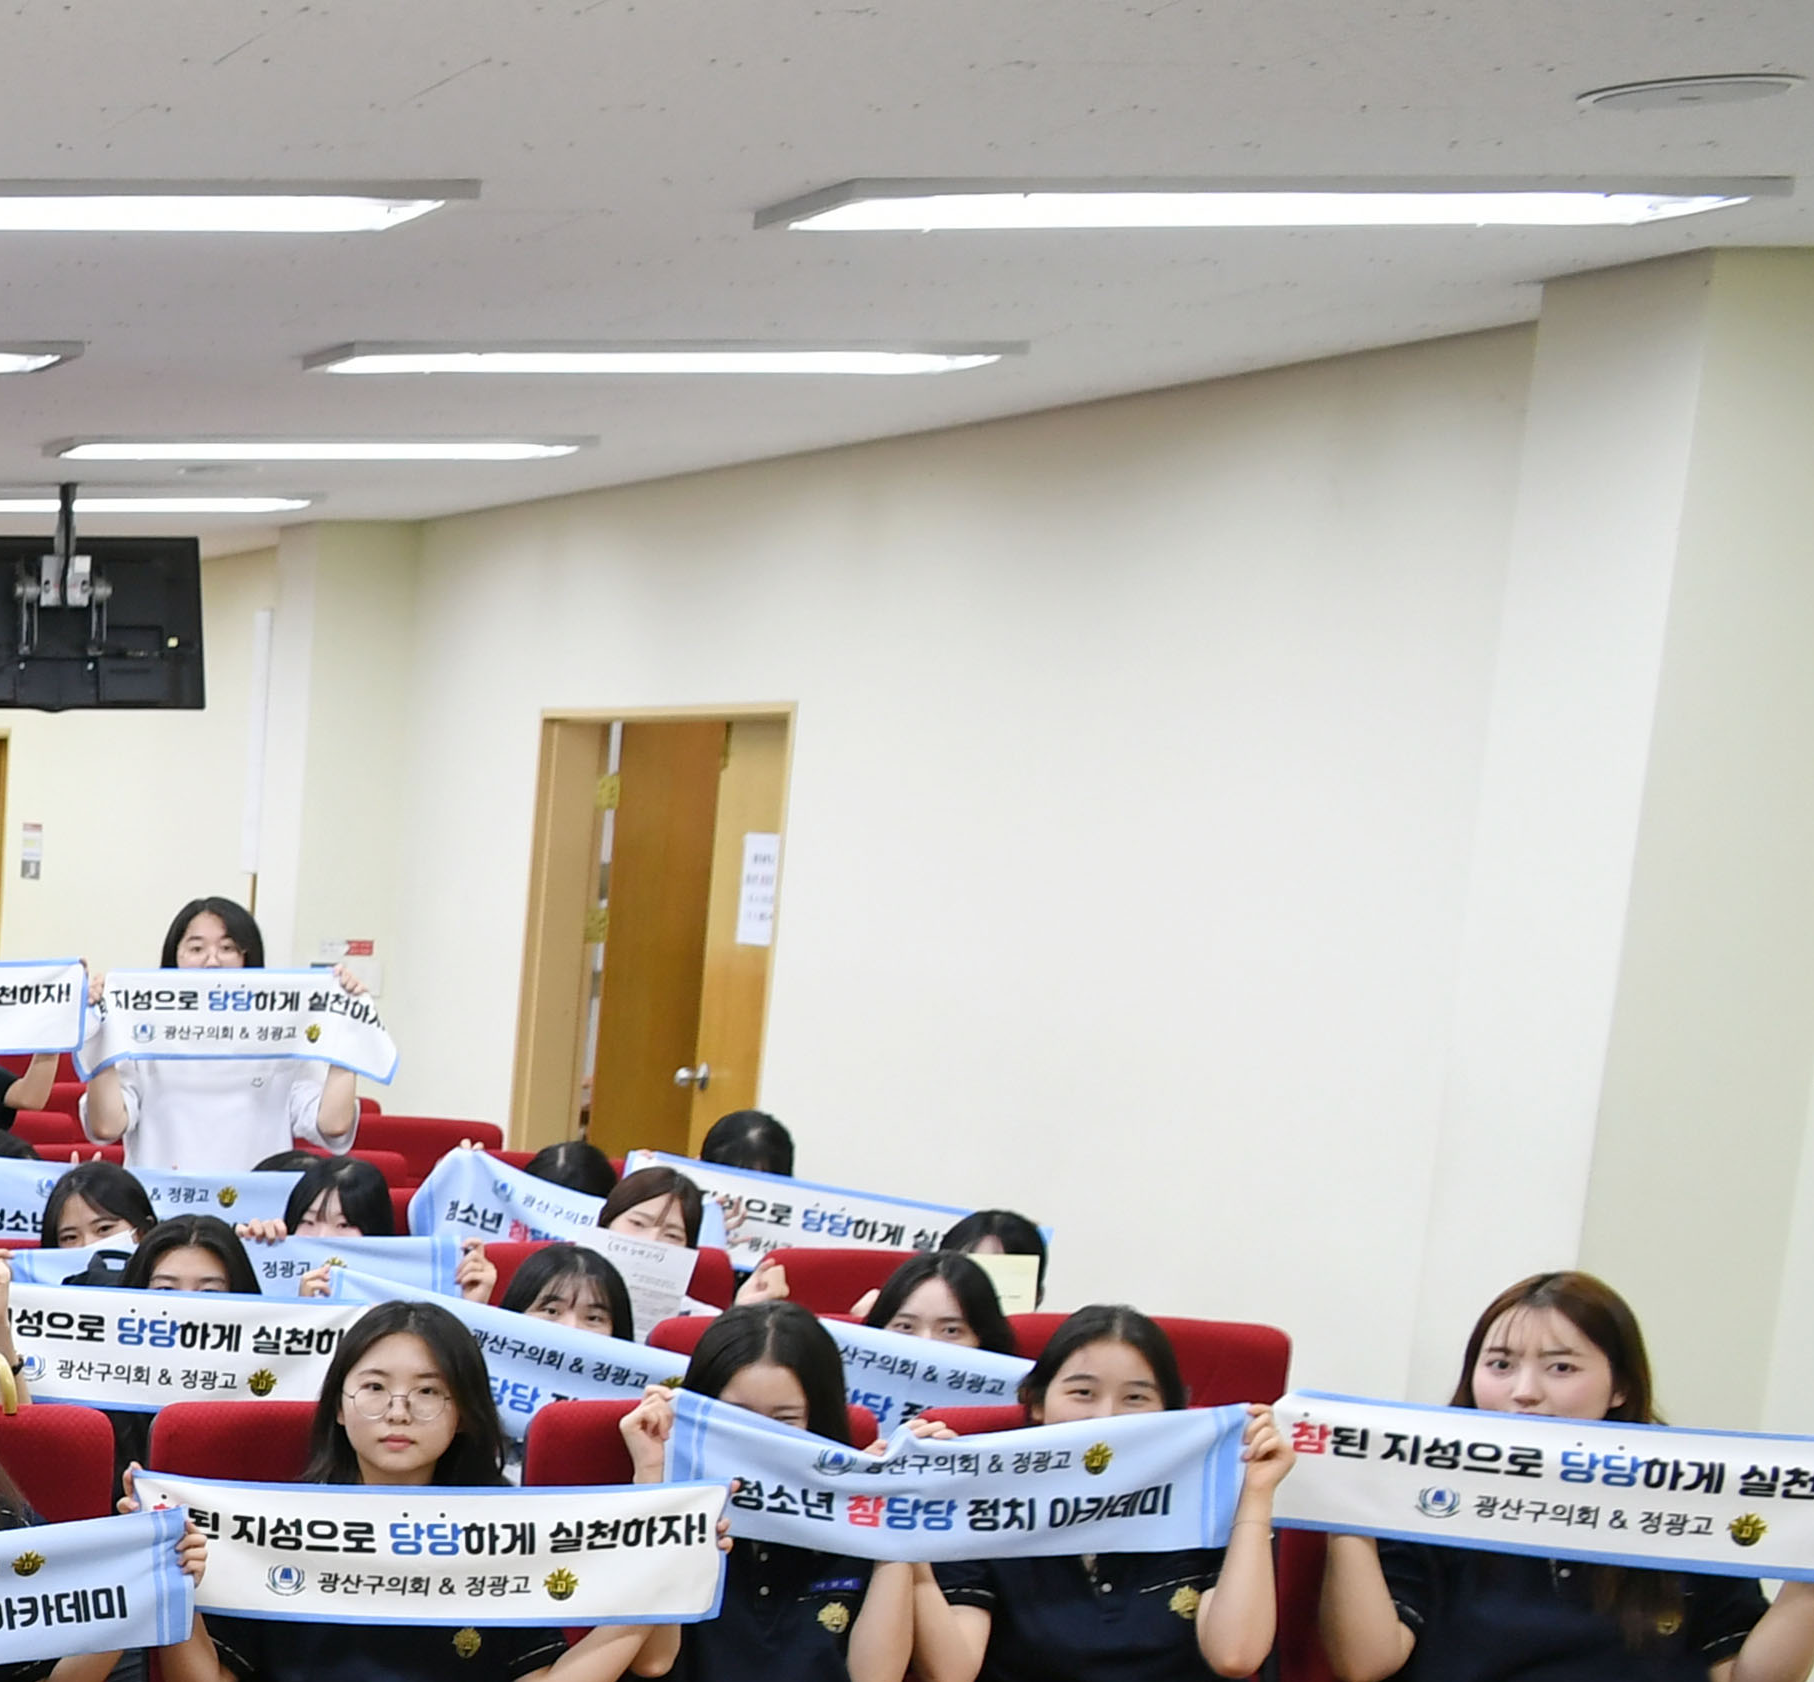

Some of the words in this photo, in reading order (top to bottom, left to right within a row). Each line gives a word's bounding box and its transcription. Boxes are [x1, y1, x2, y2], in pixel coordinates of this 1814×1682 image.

[111, 990, 198, 1010] 지성으로
[209, 991, 300, 1011] 당당하게
[165, 1026, 233, 1040] 광산구의회
[257, 1027, 296, 1041] 정광고
[169, 1187, 208, 1203] 정광고
[522, 1200, 595, 1228] 광산구의회
[802, 1210, 904, 1246] 당당하게
[263, 1261, 310, 1278] 정광고
[118, 1312, 241, 1352] 당당하게
[58, 1360, 150, 1385] 광산구의회
[181, 1370, 237, 1390] 정광고
[592, 1362, 649, 1389] 정광고
[922, 1366, 938, 1382] &
[946, 1370, 1005, 1396] 정광고
[988, 1455, 1002, 1473] &
[1012, 1451, 1071, 1474] 정광고
[1293, 1422, 1368, 1458] 참된
[1381, 1433, 1542, 1478] 지성으로
[1560, 1453, 1724, 1494] 당당하게
[729, 1477, 834, 1521] 청소년
[848, 1491, 957, 1530] 참당당
[968, 1498, 1035, 1531] 정치
[1049, 1484, 1172, 1528] 아카데미
[1475, 1496, 1599, 1529] 광산구의회
[1609, 1510, 1626, 1529] &
[1640, 1512, 1712, 1536] 정광고
[231, 1515, 376, 1553] 지성으로
[390, 1523, 535, 1555] 당당하게
[550, 1513, 706, 1553] 실천하자!
[318, 1573, 430, 1596] 광산구의회
[439, 1578, 455, 1594] &
[465, 1576, 530, 1596] 정광고
